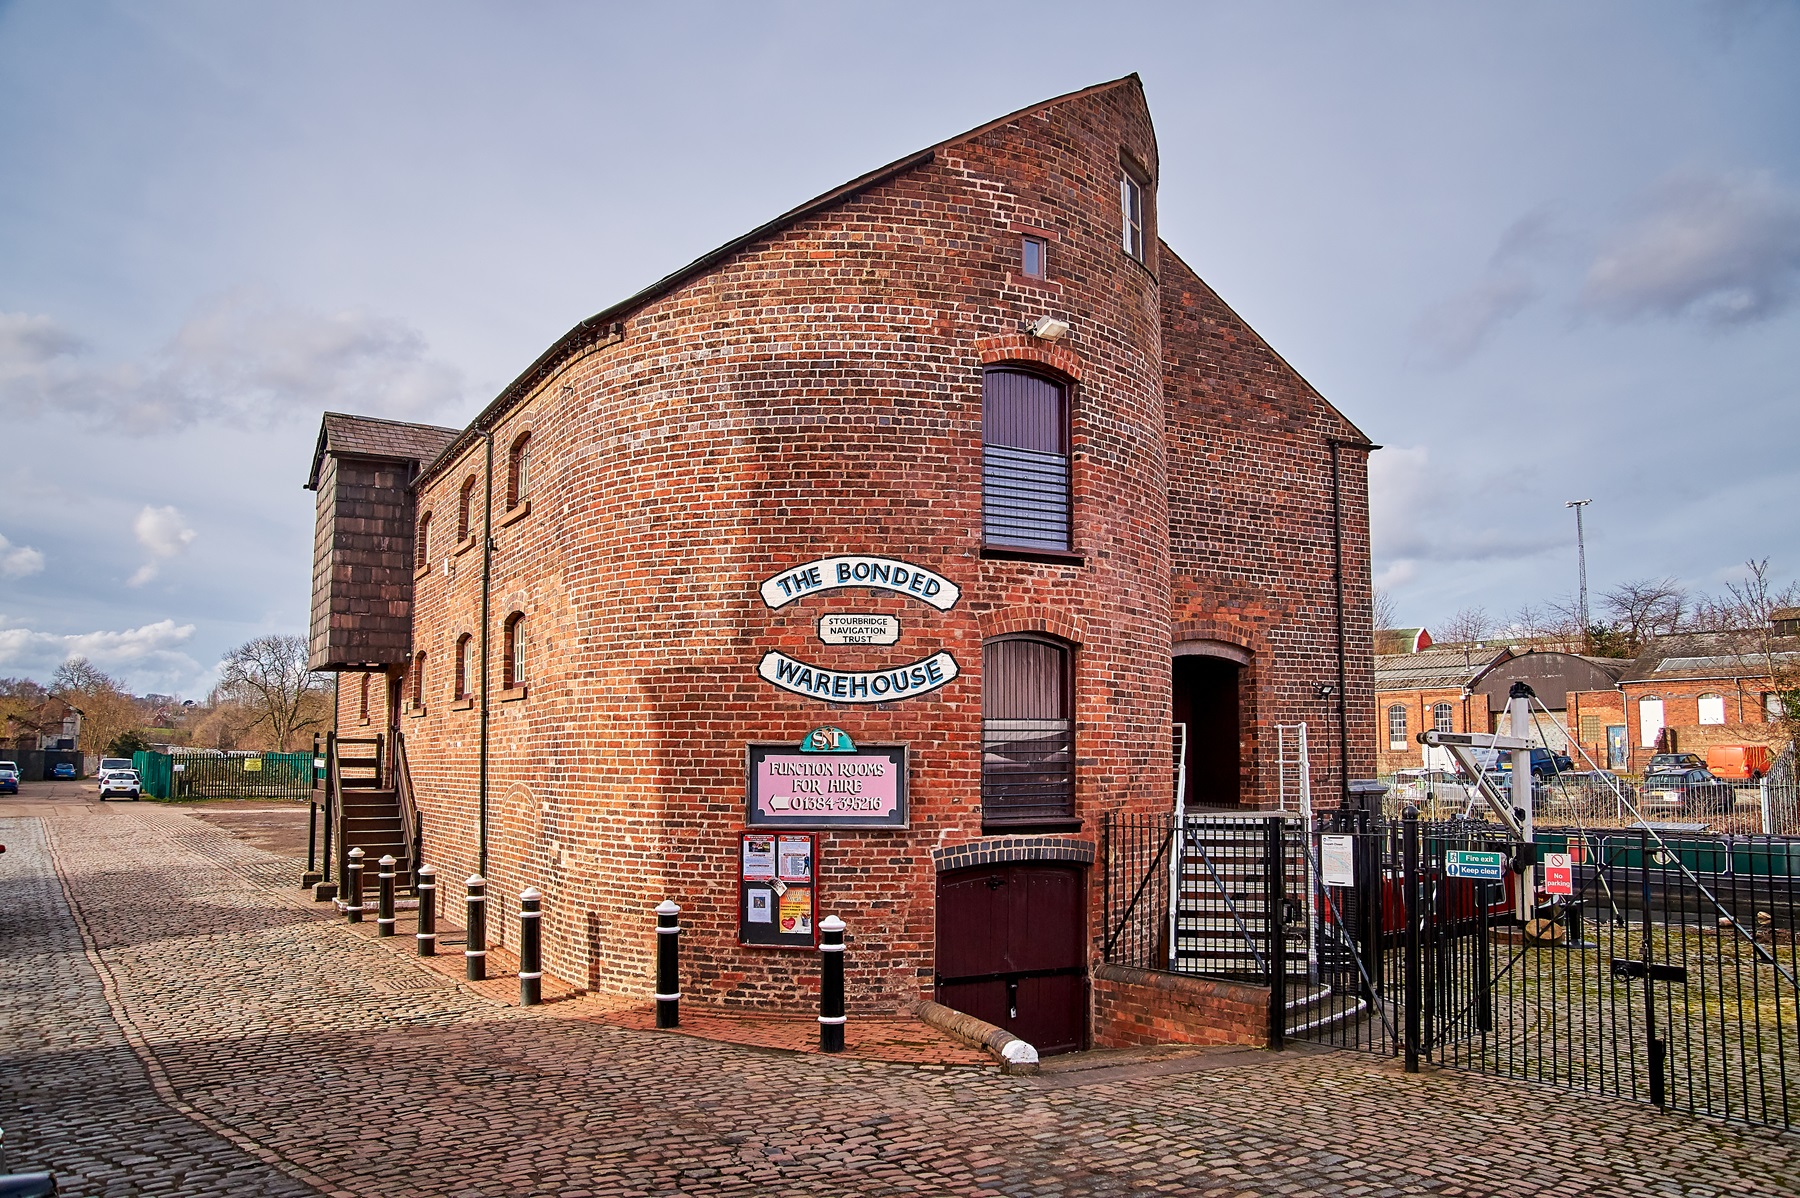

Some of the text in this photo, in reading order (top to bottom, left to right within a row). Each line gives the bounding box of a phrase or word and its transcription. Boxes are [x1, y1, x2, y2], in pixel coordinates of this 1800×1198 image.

[776, 562, 941, 598] THE BONDED
[828, 617, 888, 626] STOURBRIDGE
[830, 627, 886, 635] NAVIGATION
[842, 635, 873, 643] TRUST
[776, 658, 944, 698] WAREHOUSE
[770, 762, 885, 777] FUNCTION ROOMS
[792, 779, 864, 795] FOR HIRE
[790, 796, 882, 812] 01384-395216
[1465, 854, 1494, 863] Fire exit
[1461, 866, 1498, 875] Keep clear
[1547, 879, 1571, 888] parking
